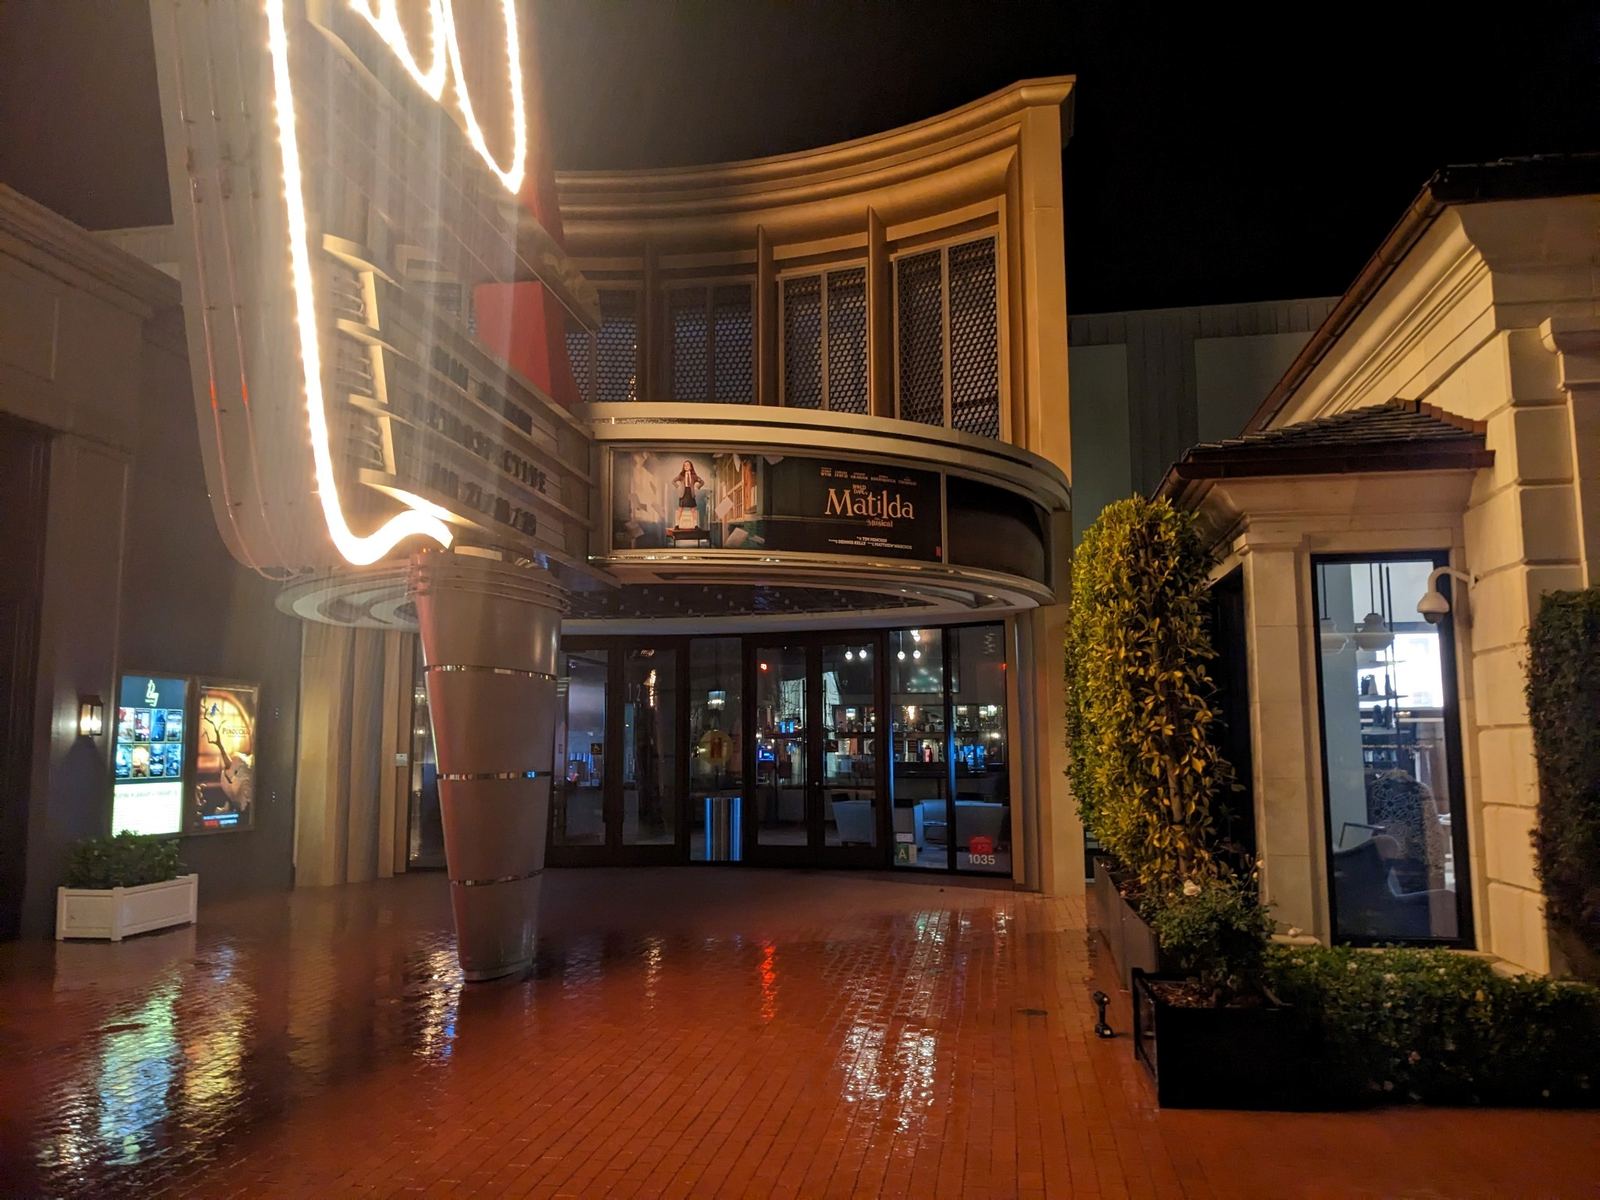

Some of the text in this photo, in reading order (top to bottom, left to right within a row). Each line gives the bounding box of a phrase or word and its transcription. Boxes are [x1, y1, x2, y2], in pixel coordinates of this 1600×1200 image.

[824, 488, 915, 519] Matilda
[898, 848, 907, 859] A
[968, 854, 996, 865] 1035
